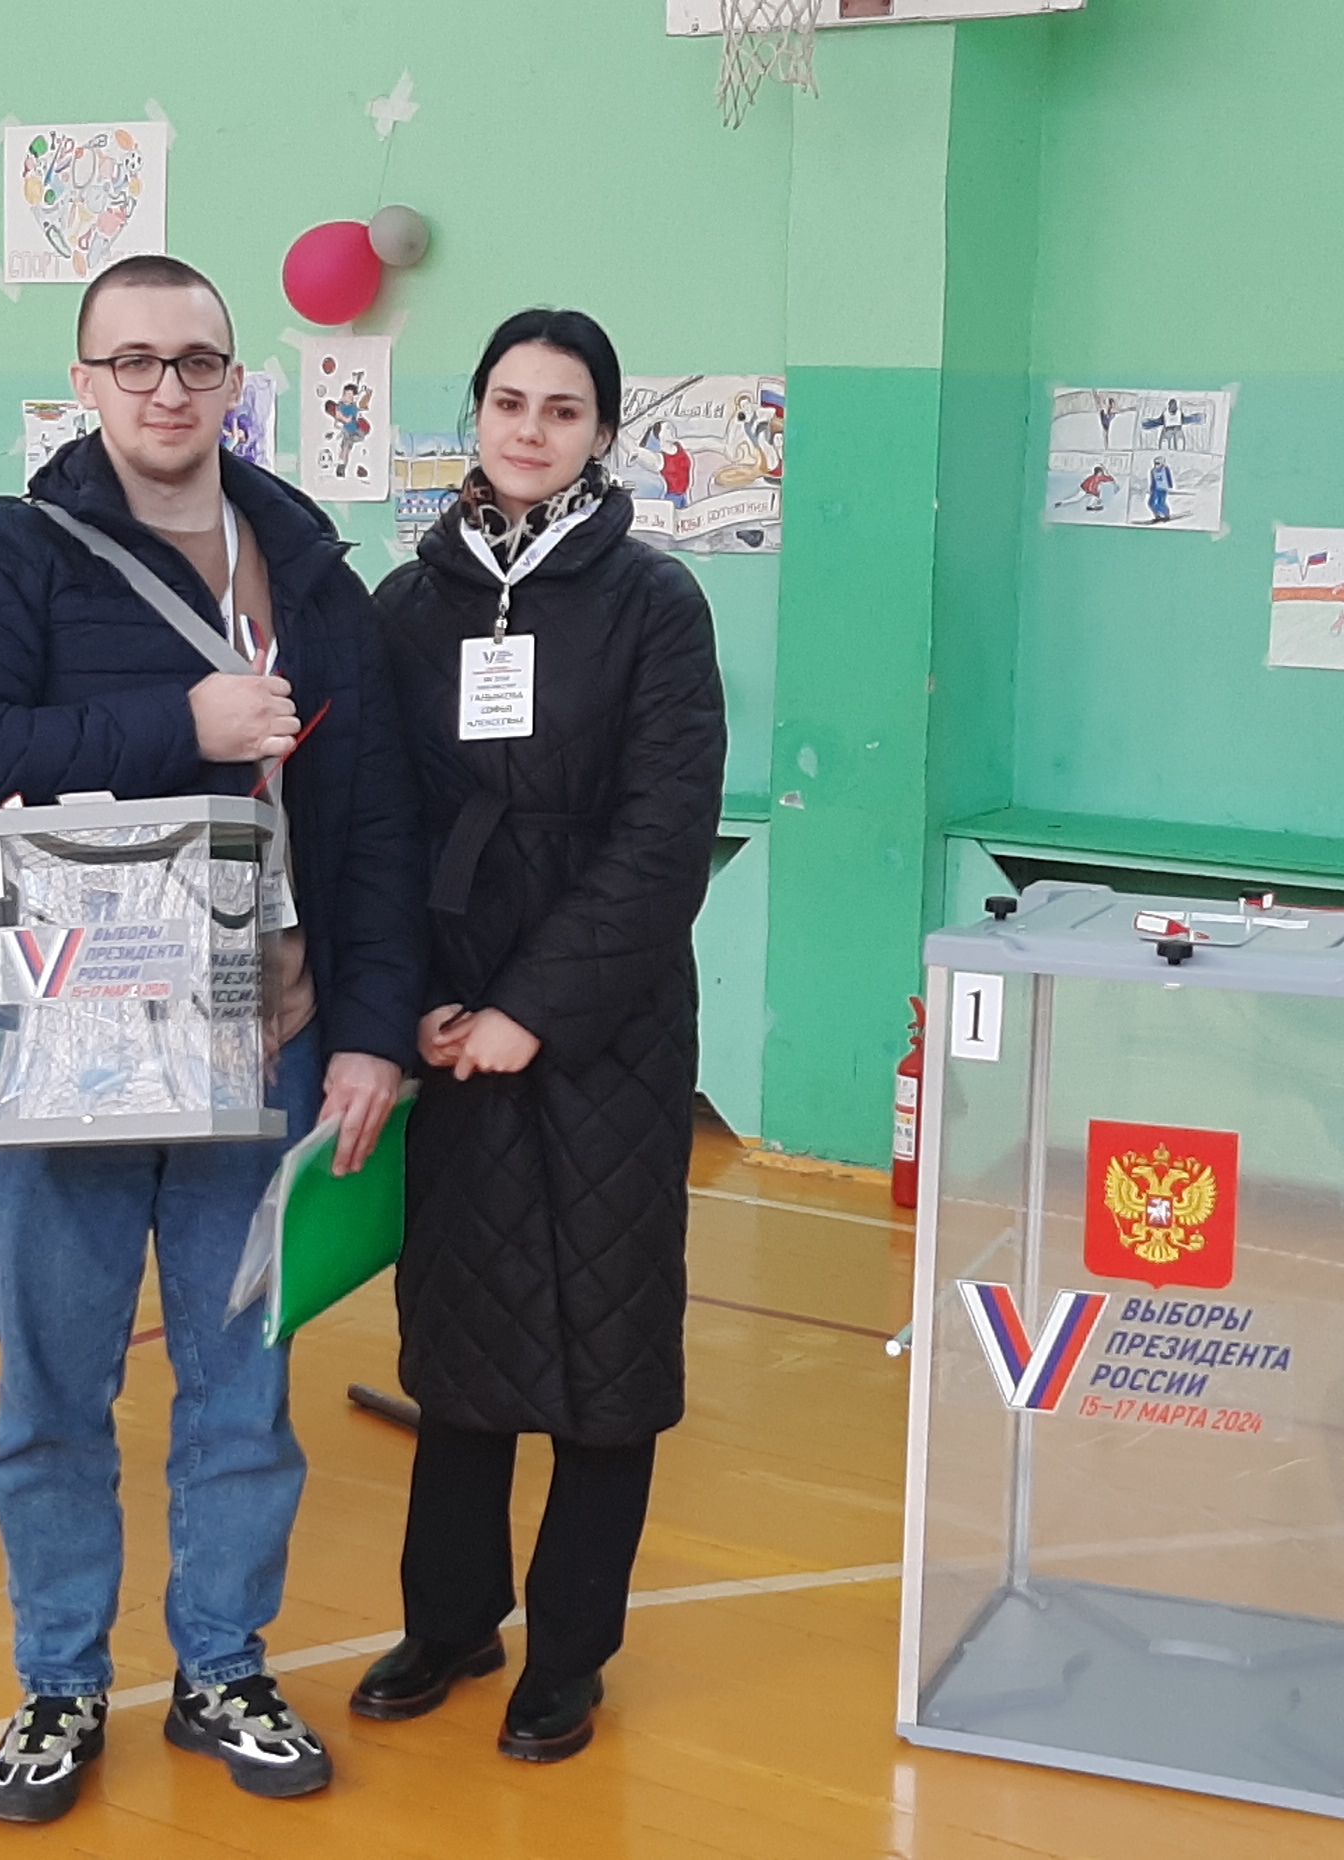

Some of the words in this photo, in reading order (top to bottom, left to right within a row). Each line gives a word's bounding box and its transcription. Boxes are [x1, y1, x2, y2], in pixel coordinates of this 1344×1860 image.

[93, 925, 164, 941] ВЫБОРЫ
[85, 944, 186, 962] ПРЕЗИДЕНТА
[77, 965, 142, 981] РОССИИ
[966, 989, 985, 1042] 1
[1120, 1298, 1253, 1332] ВЫБОРЫ
[1105, 1331, 1292, 1371] ПРЕЗИДЕНТА
[1090, 1364, 1209, 1398] РОССИИ
[1136, 1402, 1206, 1428] МАРТА
[1211, 1409, 1264, 1433] 2024
